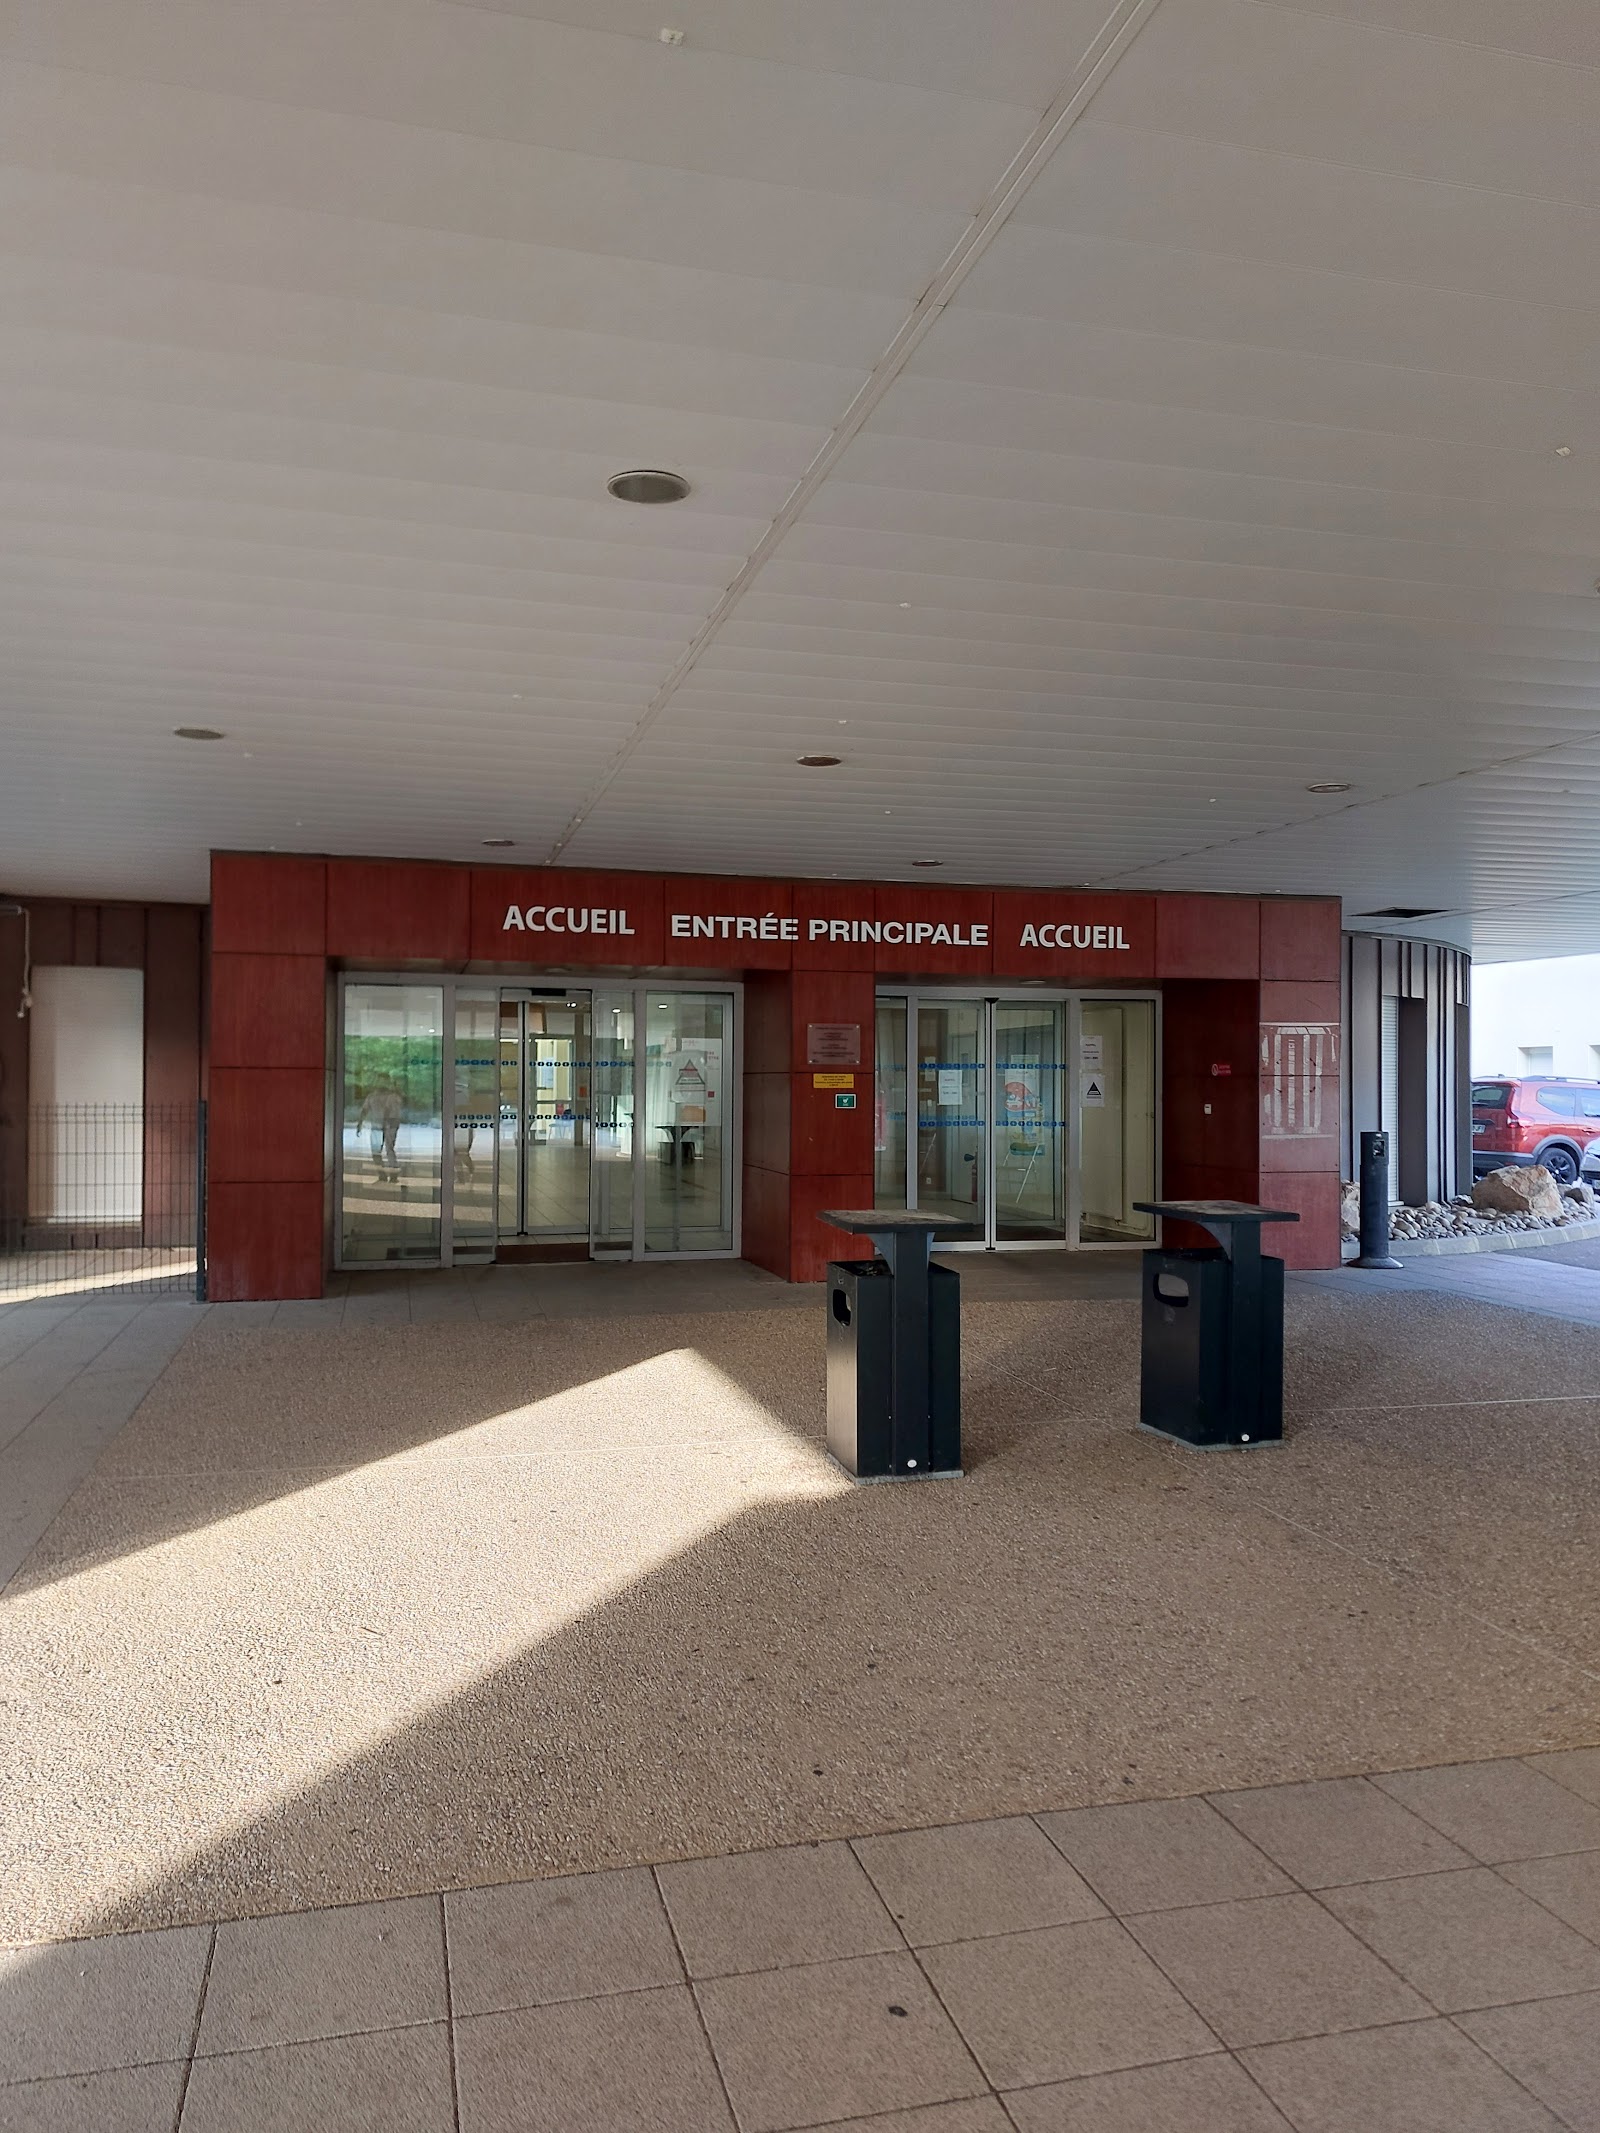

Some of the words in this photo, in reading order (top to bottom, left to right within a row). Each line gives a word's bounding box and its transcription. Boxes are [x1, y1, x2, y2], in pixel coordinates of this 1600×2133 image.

[503, 905, 635, 935] ACCUEIL
[671, 912, 799, 941] ENTRÉE
[809, 919, 989, 946] PRINCIPALE
[1019, 923, 1130, 949] ACCUEIL
